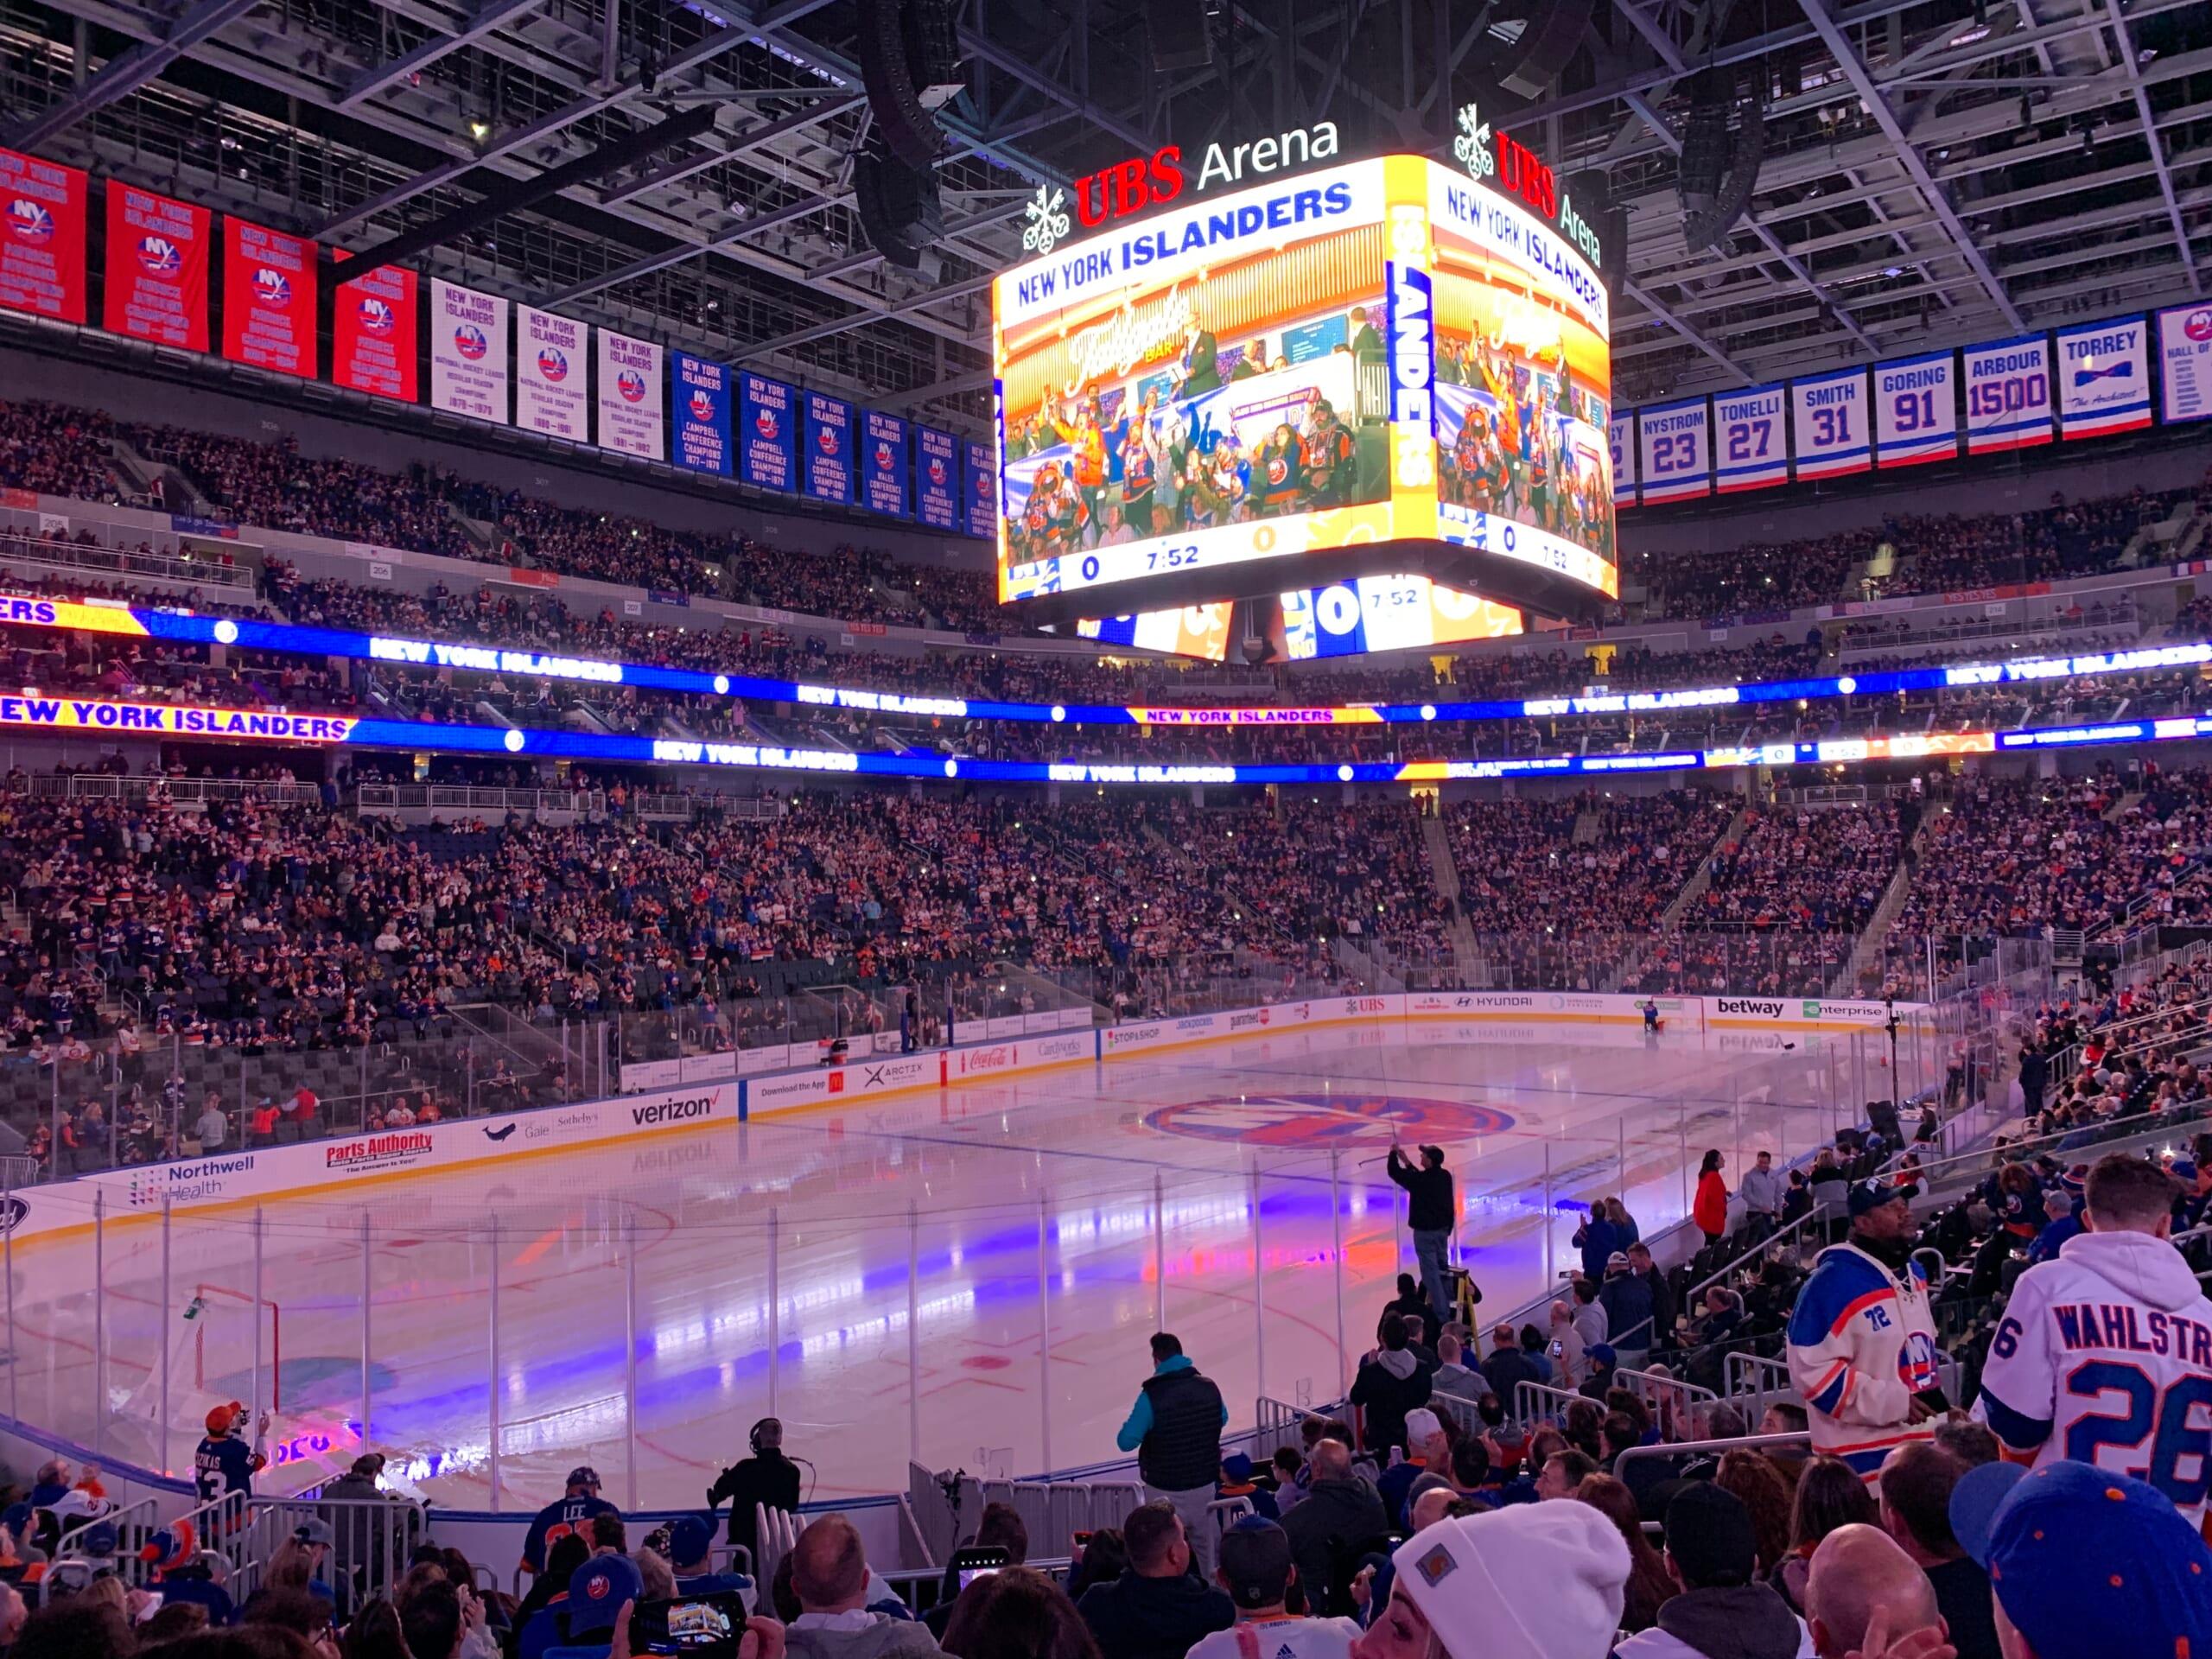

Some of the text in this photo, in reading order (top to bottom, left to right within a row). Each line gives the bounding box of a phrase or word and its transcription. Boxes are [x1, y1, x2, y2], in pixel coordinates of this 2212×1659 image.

[1075, 121, 1338, 227] UBS Arena
[1496, 130, 1601, 269] UBS Arena
[1018, 181, 1352, 308] NEW YORK ISLANDERS
[1447, 184, 1603, 319] NEW YORK ISLANDERS
[446, 288, 493, 313] NEW YORK
[446, 302, 494, 327] ISLANDERS
[530, 312, 575, 335] NEW YORK
[530, 325, 575, 350] ISLANDERS
[610, 335, 652, 359] NEW YORK
[2067, 330, 2138, 360] TORREY
[610, 349, 652, 372] ISLANDERS
[1144, 342, 1173, 363] BAR
[2167, 342, 2210, 359] HALL OF
[682, 358, 721, 378] NEW YORK
[1973, 350, 2041, 378] ARBOUR
[682, 371, 721, 391] ISLANDERS
[749, 378, 785, 397] NEW YORK
[1884, 366, 1945, 392] GORING
[749, 390, 785, 410] ISLANDERS
[812, 397, 844, 416] NEW YORK
[1806, 383, 1855, 408] SMITH
[1969, 373, 2046, 416] 1500
[812, 409, 845, 428] ISLANDERS
[1720, 397, 1779, 422] TONELLI
[1895, 390, 1936, 432] 91
[685, 422, 719, 438] CAMPBELL
[869, 414, 900, 432] NEW YORK
[869, 426, 900, 443] ISLANDERS
[1643, 411, 1704, 435] NYSTROM
[1812, 405, 1852, 448] 31
[753, 439, 783, 454] CAMPBELL
[923, 431, 951, 448] NEW YORK
[923, 442, 952, 459] ISLANDERS
[1728, 419, 1771, 461] 27
[815, 456, 843, 471] CAMPBELL
[1653, 432, 1696, 474] 23
[877, 472, 894, 484] WALES
[930, 486, 946, 498] WALES
[1503, 525, 1516, 552] 0
[1082, 525, 1276, 581] 0 7:52 0
[1316, 585, 1361, 635] 0
[369, 638, 623, 683] NEW YORK ISLANDERS
[1946, 665, 2003, 685] NEW
[2005, 658, 2071, 680] YORK
[798, 684, 968, 717] NEW YORK ISLANDERS
[1523, 687, 1739, 716] NEW YORK ISLANDERS
[73, 703, 164, 729] YORK
[175, 710, 350, 740] ISLANDERS
[1147, 709, 1333, 723] NEW YORK ISLANDERS
[652, 741, 857, 771] NEW YORK ISLANDERS
[1048, 765, 1236, 783] NEW YORK ISLANDERS
[1359, 999, 1384, 1012] UBS
[1477, 997, 1532, 1007] HYUNDAI
[1718, 999, 1783, 1018] betway
[1806, 1005, 1883, 1017] enterprise
[885, 1064, 923, 1077] ARCTIX
[761, 1079, 826, 1097] Download the App
[632, 1096, 711, 1125] verizon
[525, 1125, 550, 1139] Gale
[327, 1133, 432, 1161] Parts Authority
[169, 1156, 254, 1181] Northwell
[169, 1179, 222, 1202] Health
[1863, 1306, 1892, 1332] 72
[1993, 1316, 2023, 1360] 6
[2051, 1304, 2212, 1370] WAHLSTR
[2064, 1358, 2212, 1507] 26
[563, 1504, 586, 1522] LEE
